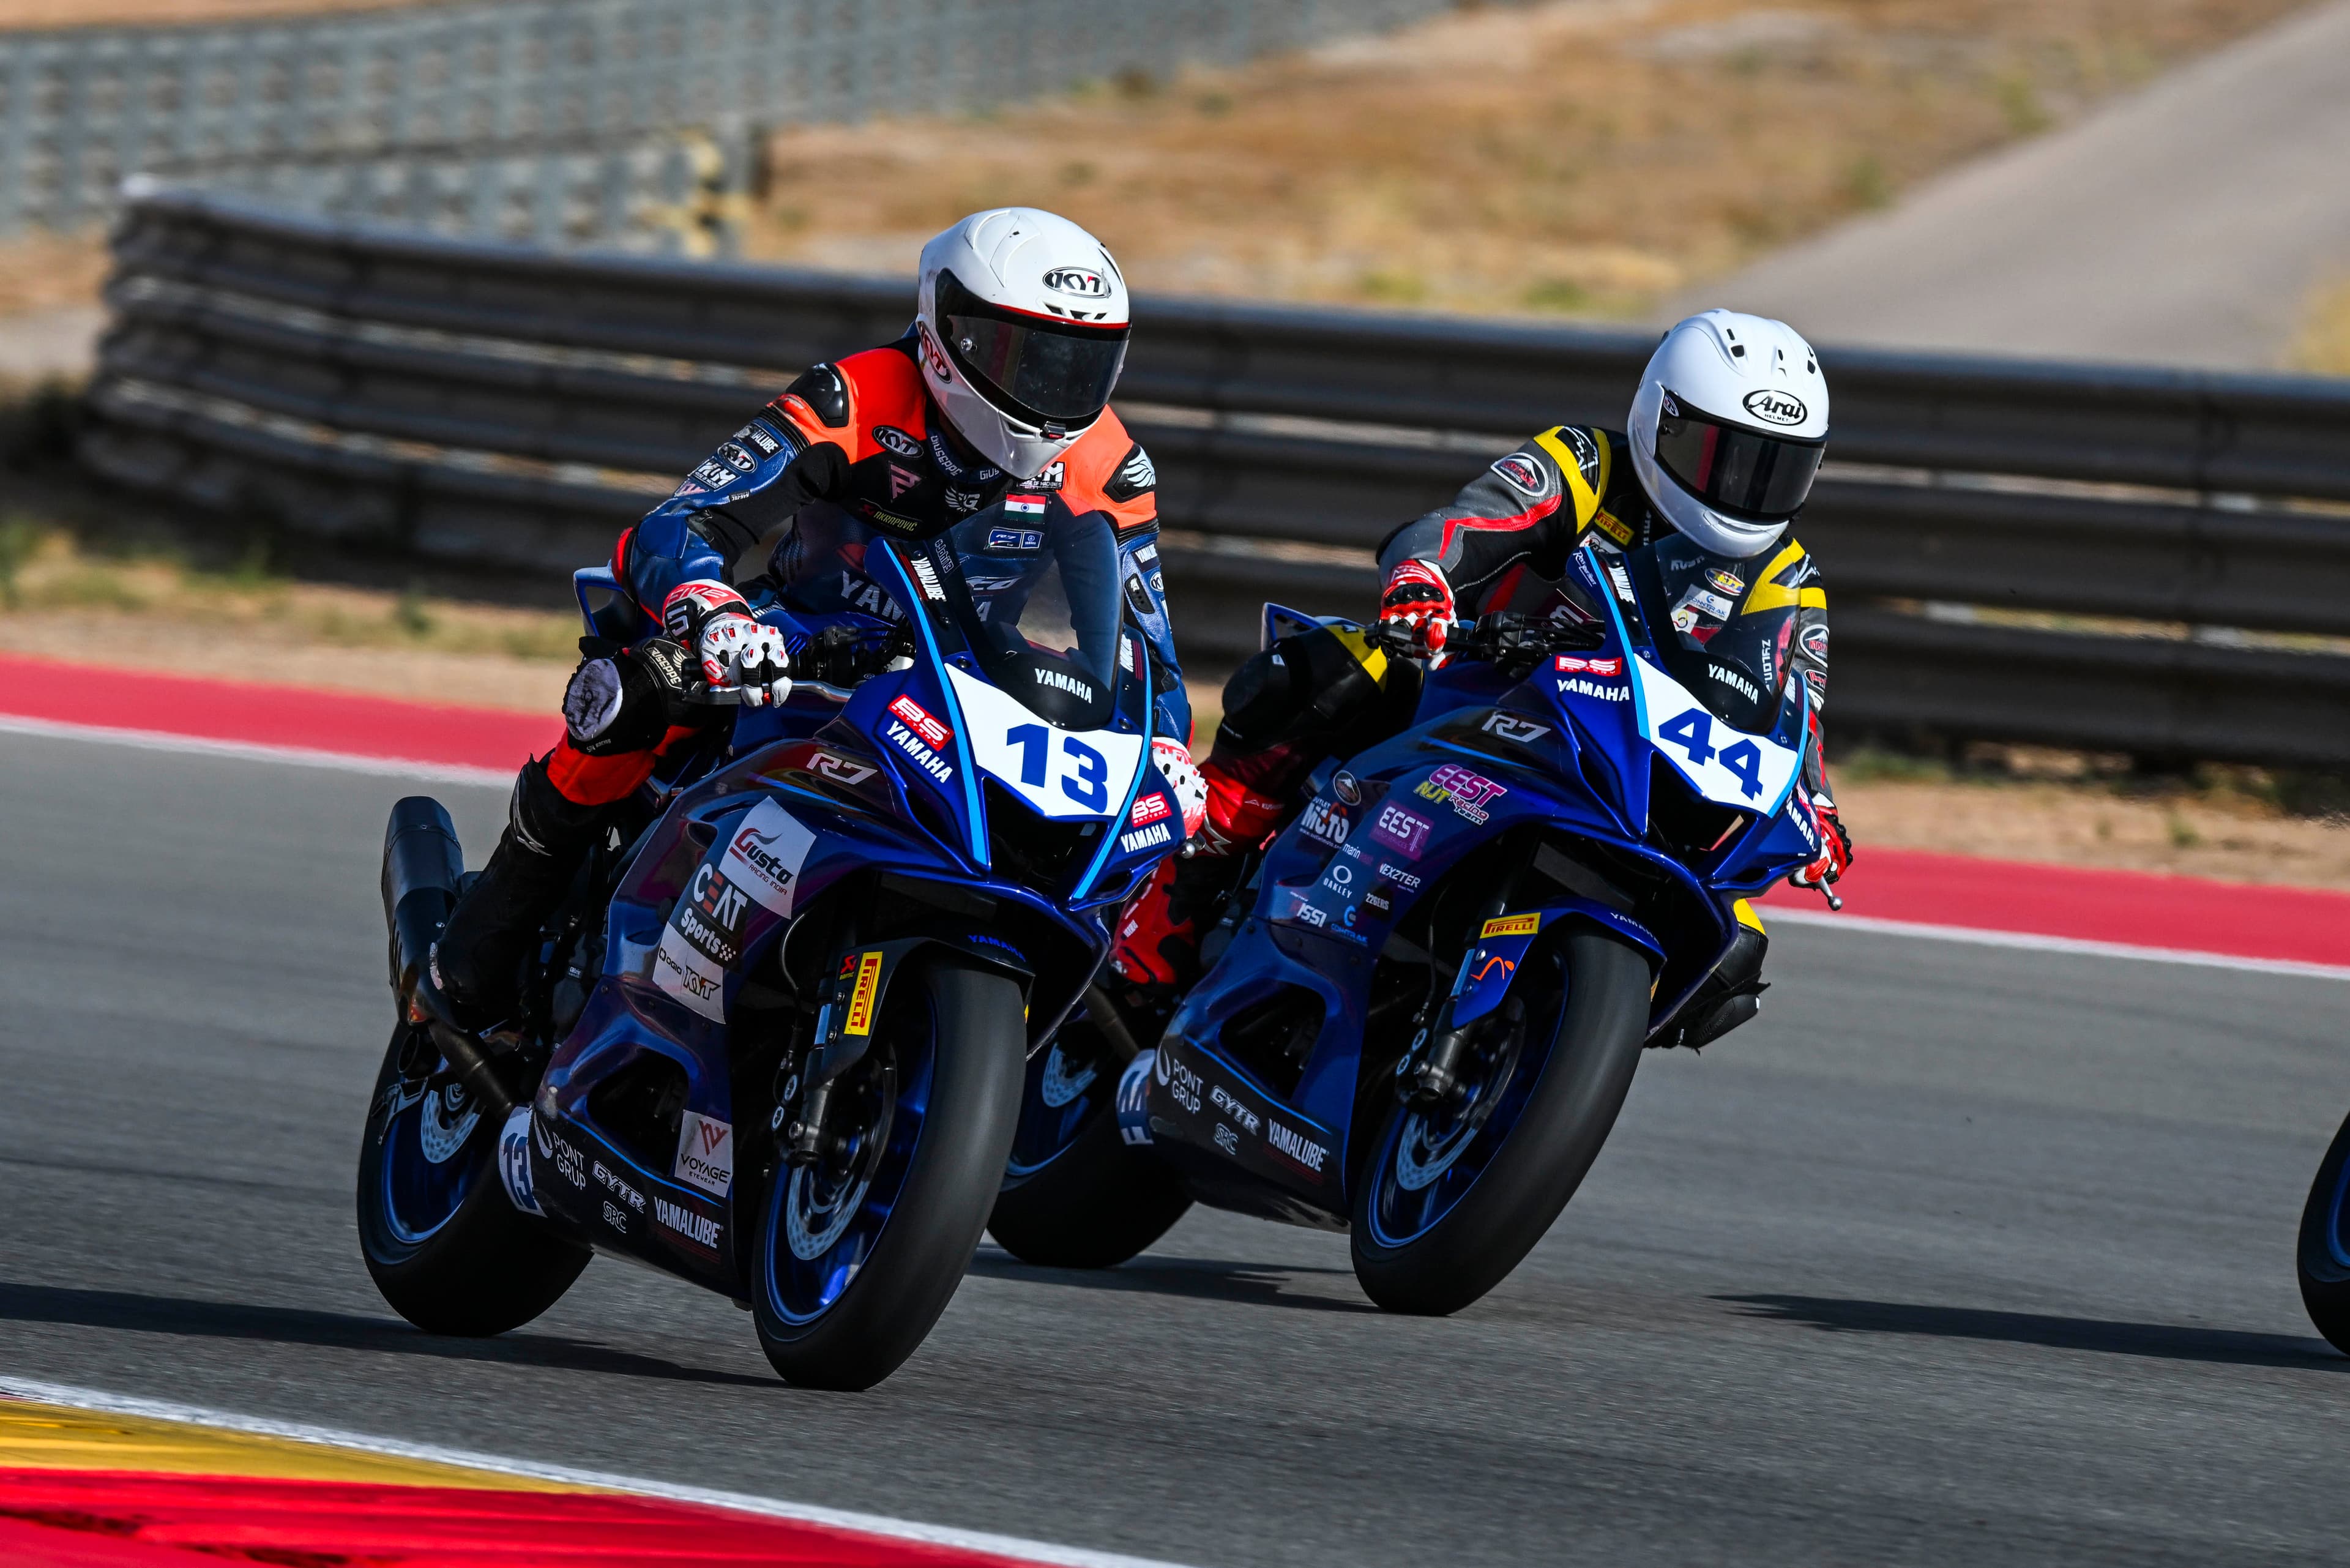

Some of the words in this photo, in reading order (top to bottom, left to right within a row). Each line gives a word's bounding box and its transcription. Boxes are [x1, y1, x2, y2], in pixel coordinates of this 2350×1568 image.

[1051, 270, 1104, 294] KYT
[1747, 395, 1803, 419] Arai
[1764, 413, 1789, 422] HELMET
[877, 430, 917, 454] KYT
[1596, 511, 1628, 540] PIRELLI
[911, 557, 947, 602] YAMALUBE
[1034, 668, 1092, 704] YAMAHA
[1557, 678, 1630, 701] YAMAHA
[1708, 663, 1758, 705] YAMAHA
[890, 704, 939, 745] BATTERY
[894, 697, 948, 742] BS
[1481, 714, 1551, 742] R7
[807, 753, 878, 785] R7
[886, 720, 953, 784] YAMAHA
[1006, 723, 1108, 813] 13
[1658, 707, 1763, 801] 44
[1413, 780, 1452, 804] NJT
[1429, 764, 1508, 807] EEST
[1132, 794, 1166, 818] BS
[1133, 809, 1168, 824] BATTERY
[1300, 802, 1349, 843] MOTO
[1448, 793, 1490, 821] Racing
[1121, 823, 1171, 853] YAMAHA
[1379, 806, 1430, 853] EEST
[734, 827, 794, 885] Gusto
[748, 864, 769, 883] RACING
[770, 879, 788, 895] INDIA
[1323, 877, 1352, 898] OAKLEY
[693, 863, 748, 931] CEAT
[1365, 892, 1390, 911] 226ERS
[681, 908, 722, 955] sports
[1484, 917, 1535, 934] PIRELLI
[1610, 912, 1660, 945] YAMAHA
[968, 934, 1026, 962] YAMAHA
[666, 955, 682, 976] OGIO
[682, 965, 722, 1001] KYT
[851, 958, 878, 1028] PIRELLI
[1173, 1058, 1204, 1096] PONT
[1172, 1082, 1201, 1115] GRUP
[1209, 1085, 1262, 1137] GYTR
[552, 1131, 584, 1168] PONT
[1213, 1122, 1240, 1155] SRC
[1268, 1118, 1327, 1173] YAMALUBE
[502, 1132, 538, 1211] 13
[556, 1154, 586, 1190] GRUP
[680, 1153, 731, 1185] VOYAGE
[688, 1171, 715, 1186] EYEWEAR
[592, 1160, 647, 1214] GYTR
[603, 1200, 627, 1234] SRC
[654, 1195, 721, 1249] YAMALUBE
